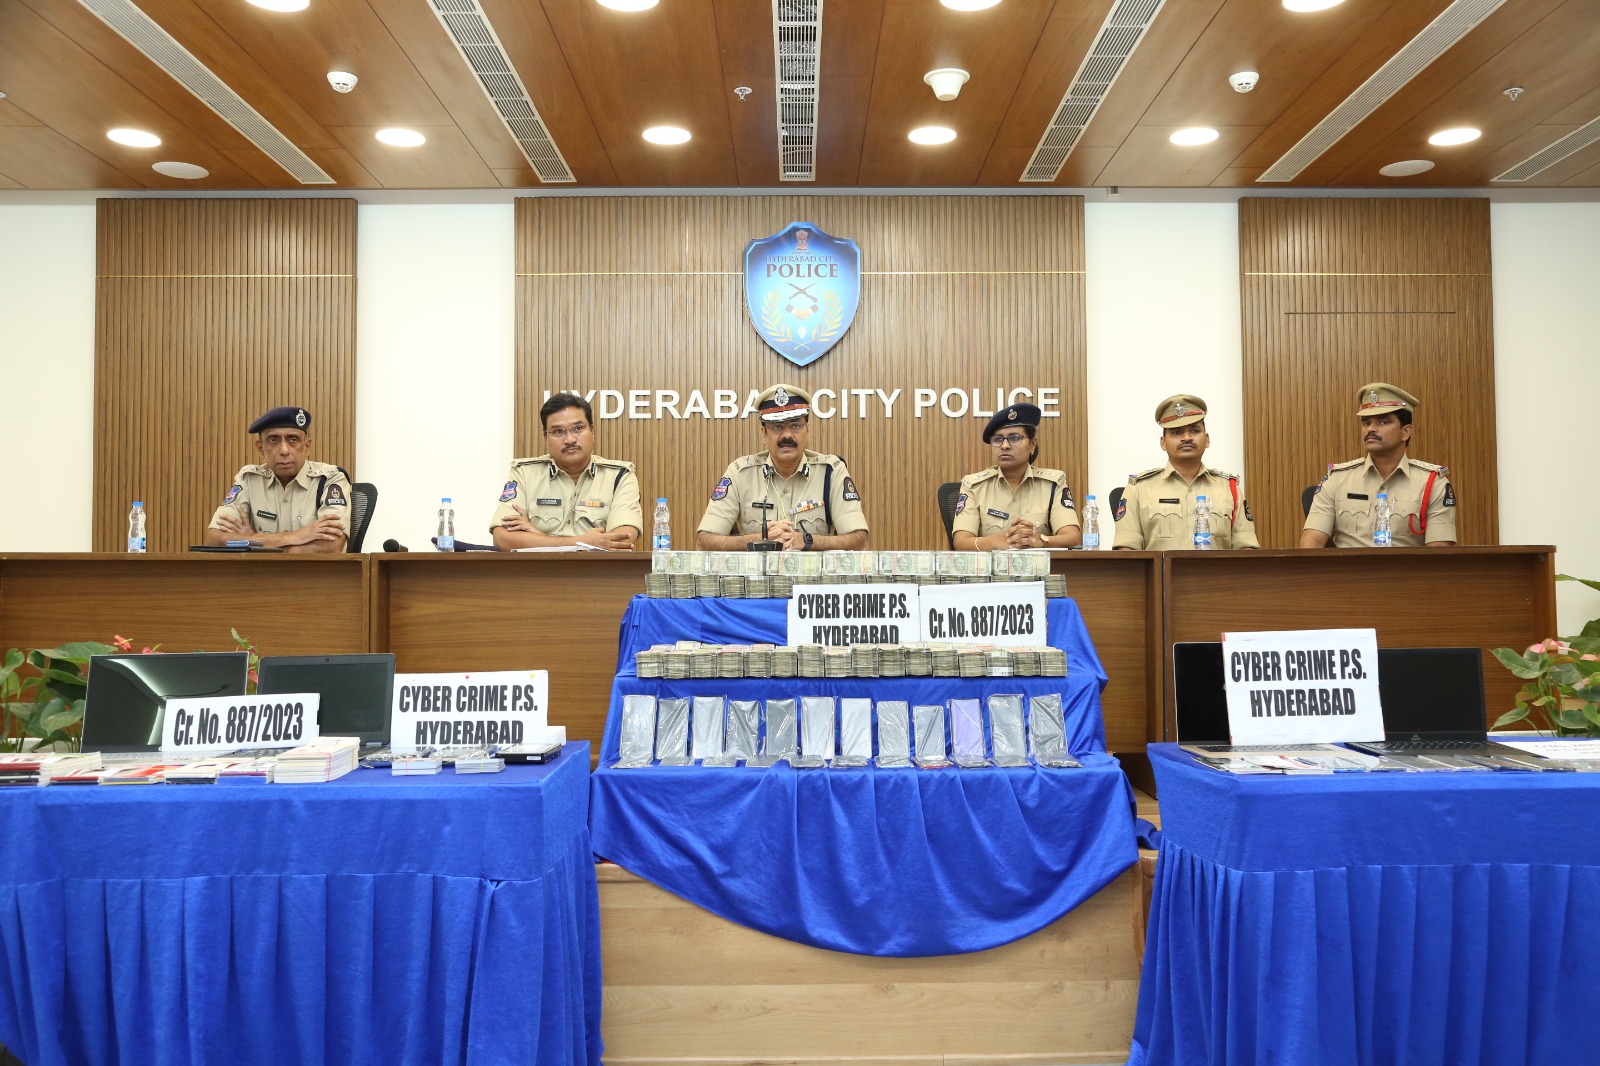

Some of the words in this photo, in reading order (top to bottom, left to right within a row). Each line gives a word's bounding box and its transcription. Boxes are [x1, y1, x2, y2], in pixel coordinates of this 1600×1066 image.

[767, 264, 838, 277] POLICE
[811, 388, 902, 419] CITY
[798, 593, 840, 619] CYBER
[843, 593, 886, 619] CRIME
[889, 593, 910, 618] P.S.
[812, 625, 899, 646] HYDERABAD
[929, 608, 946, 639] Cr.
[948, 608, 968, 638] No.
[971, 604, 1034, 637] 887/2023
[1231, 651, 1282, 682] CYBER
[1285, 650, 1337, 681] CRIME
[1340, 649, 1367, 680] P.S.
[399, 685, 452, 713] CYBER
[456, 685, 508, 712] CRIME
[511, 684, 538, 712] P.S.
[1250, 688, 1356, 717] HYDERABAD
[174, 708, 194, 746] Cr.
[197, 708, 221, 744] No.
[225, 702, 303, 743] 887/2023
[415, 720, 524, 745] HYDERABAD
